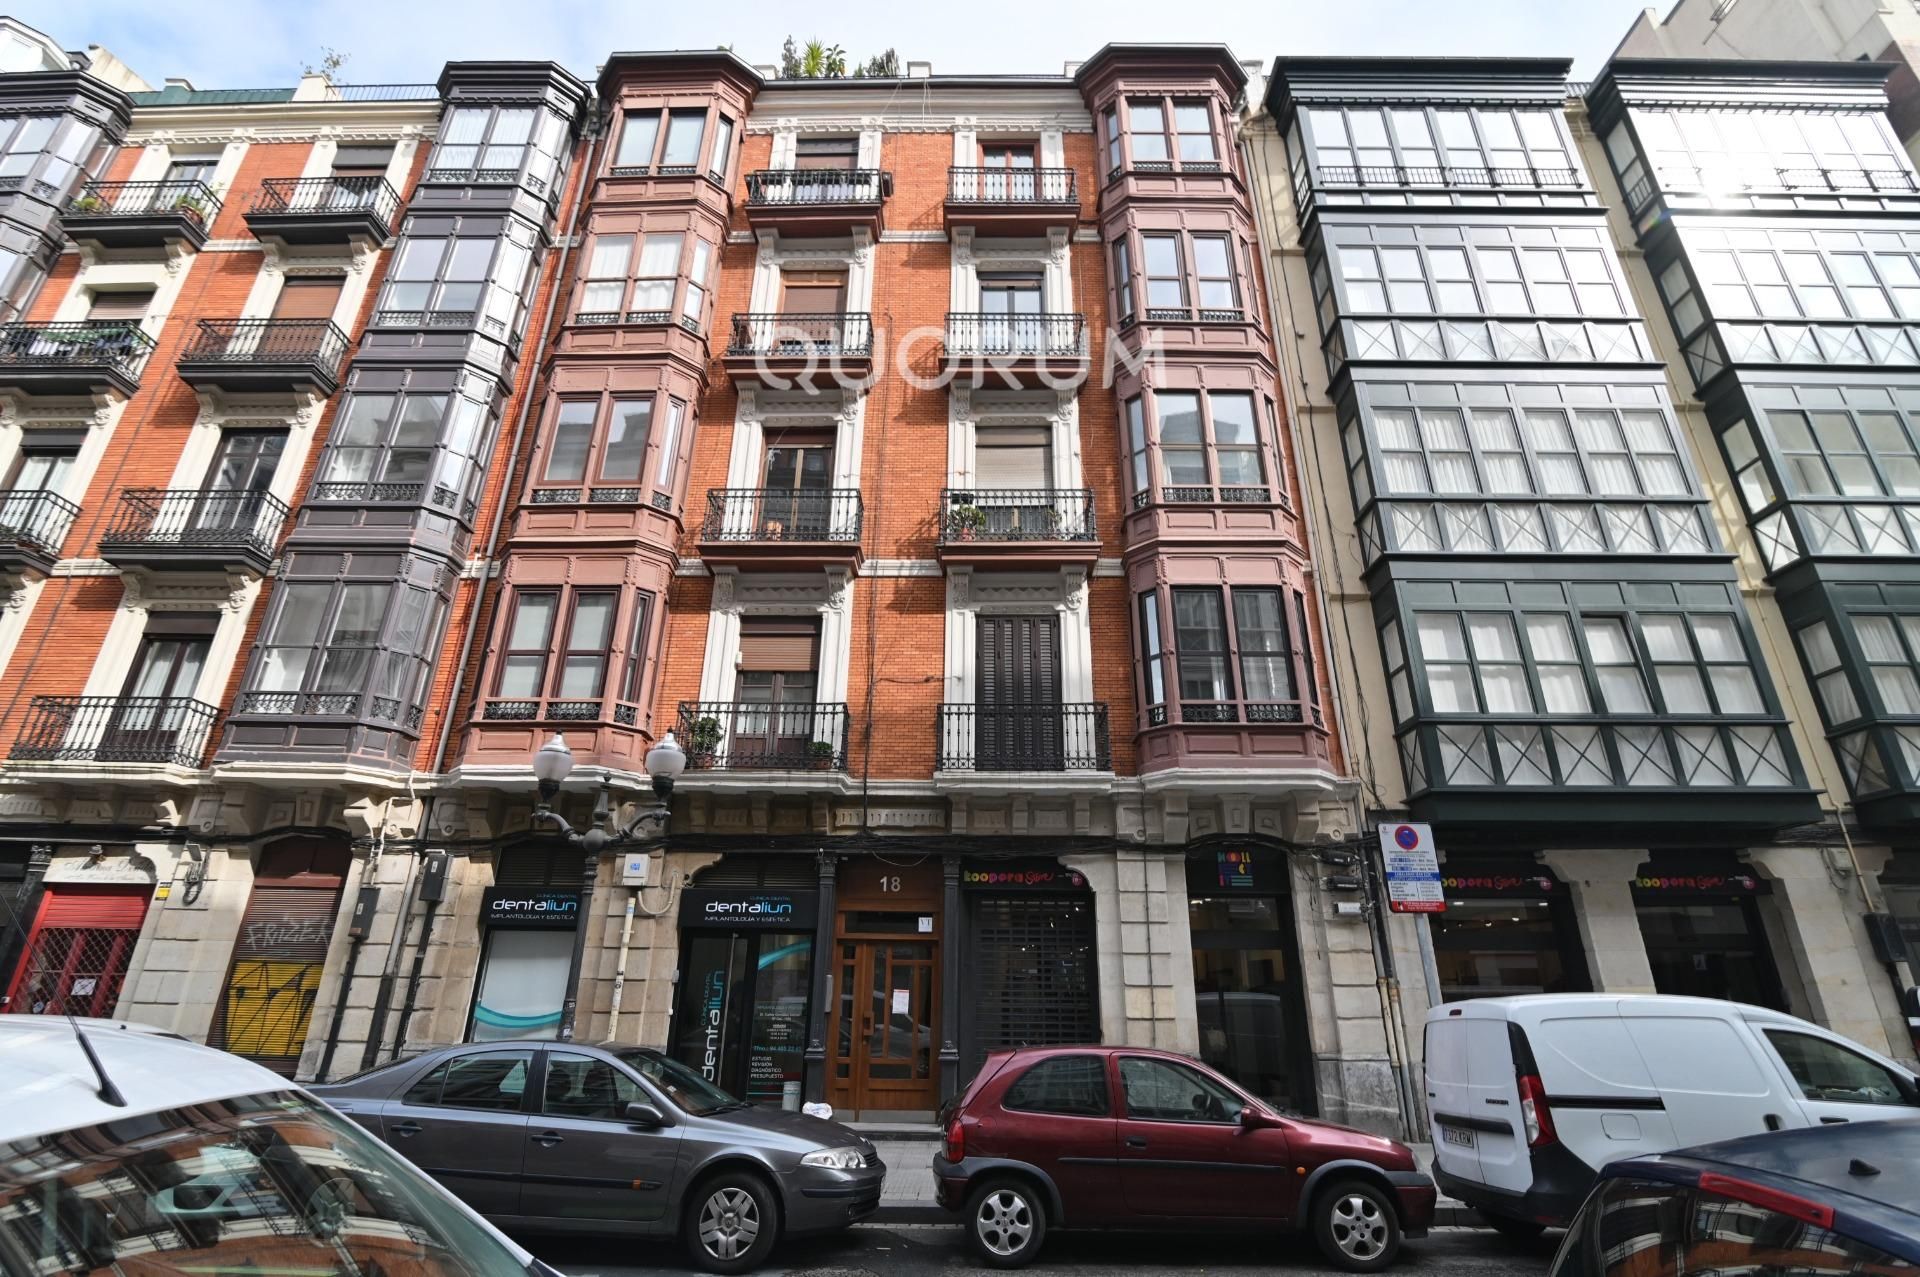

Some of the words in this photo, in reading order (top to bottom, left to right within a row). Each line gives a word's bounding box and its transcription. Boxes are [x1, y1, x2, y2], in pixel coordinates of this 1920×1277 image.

[879, 876, 901, 892] 18
[492, 898, 577, 912] dentaliun
[705, 900, 792, 914] dentaliun
[701, 970, 725, 1082] dentaliun
